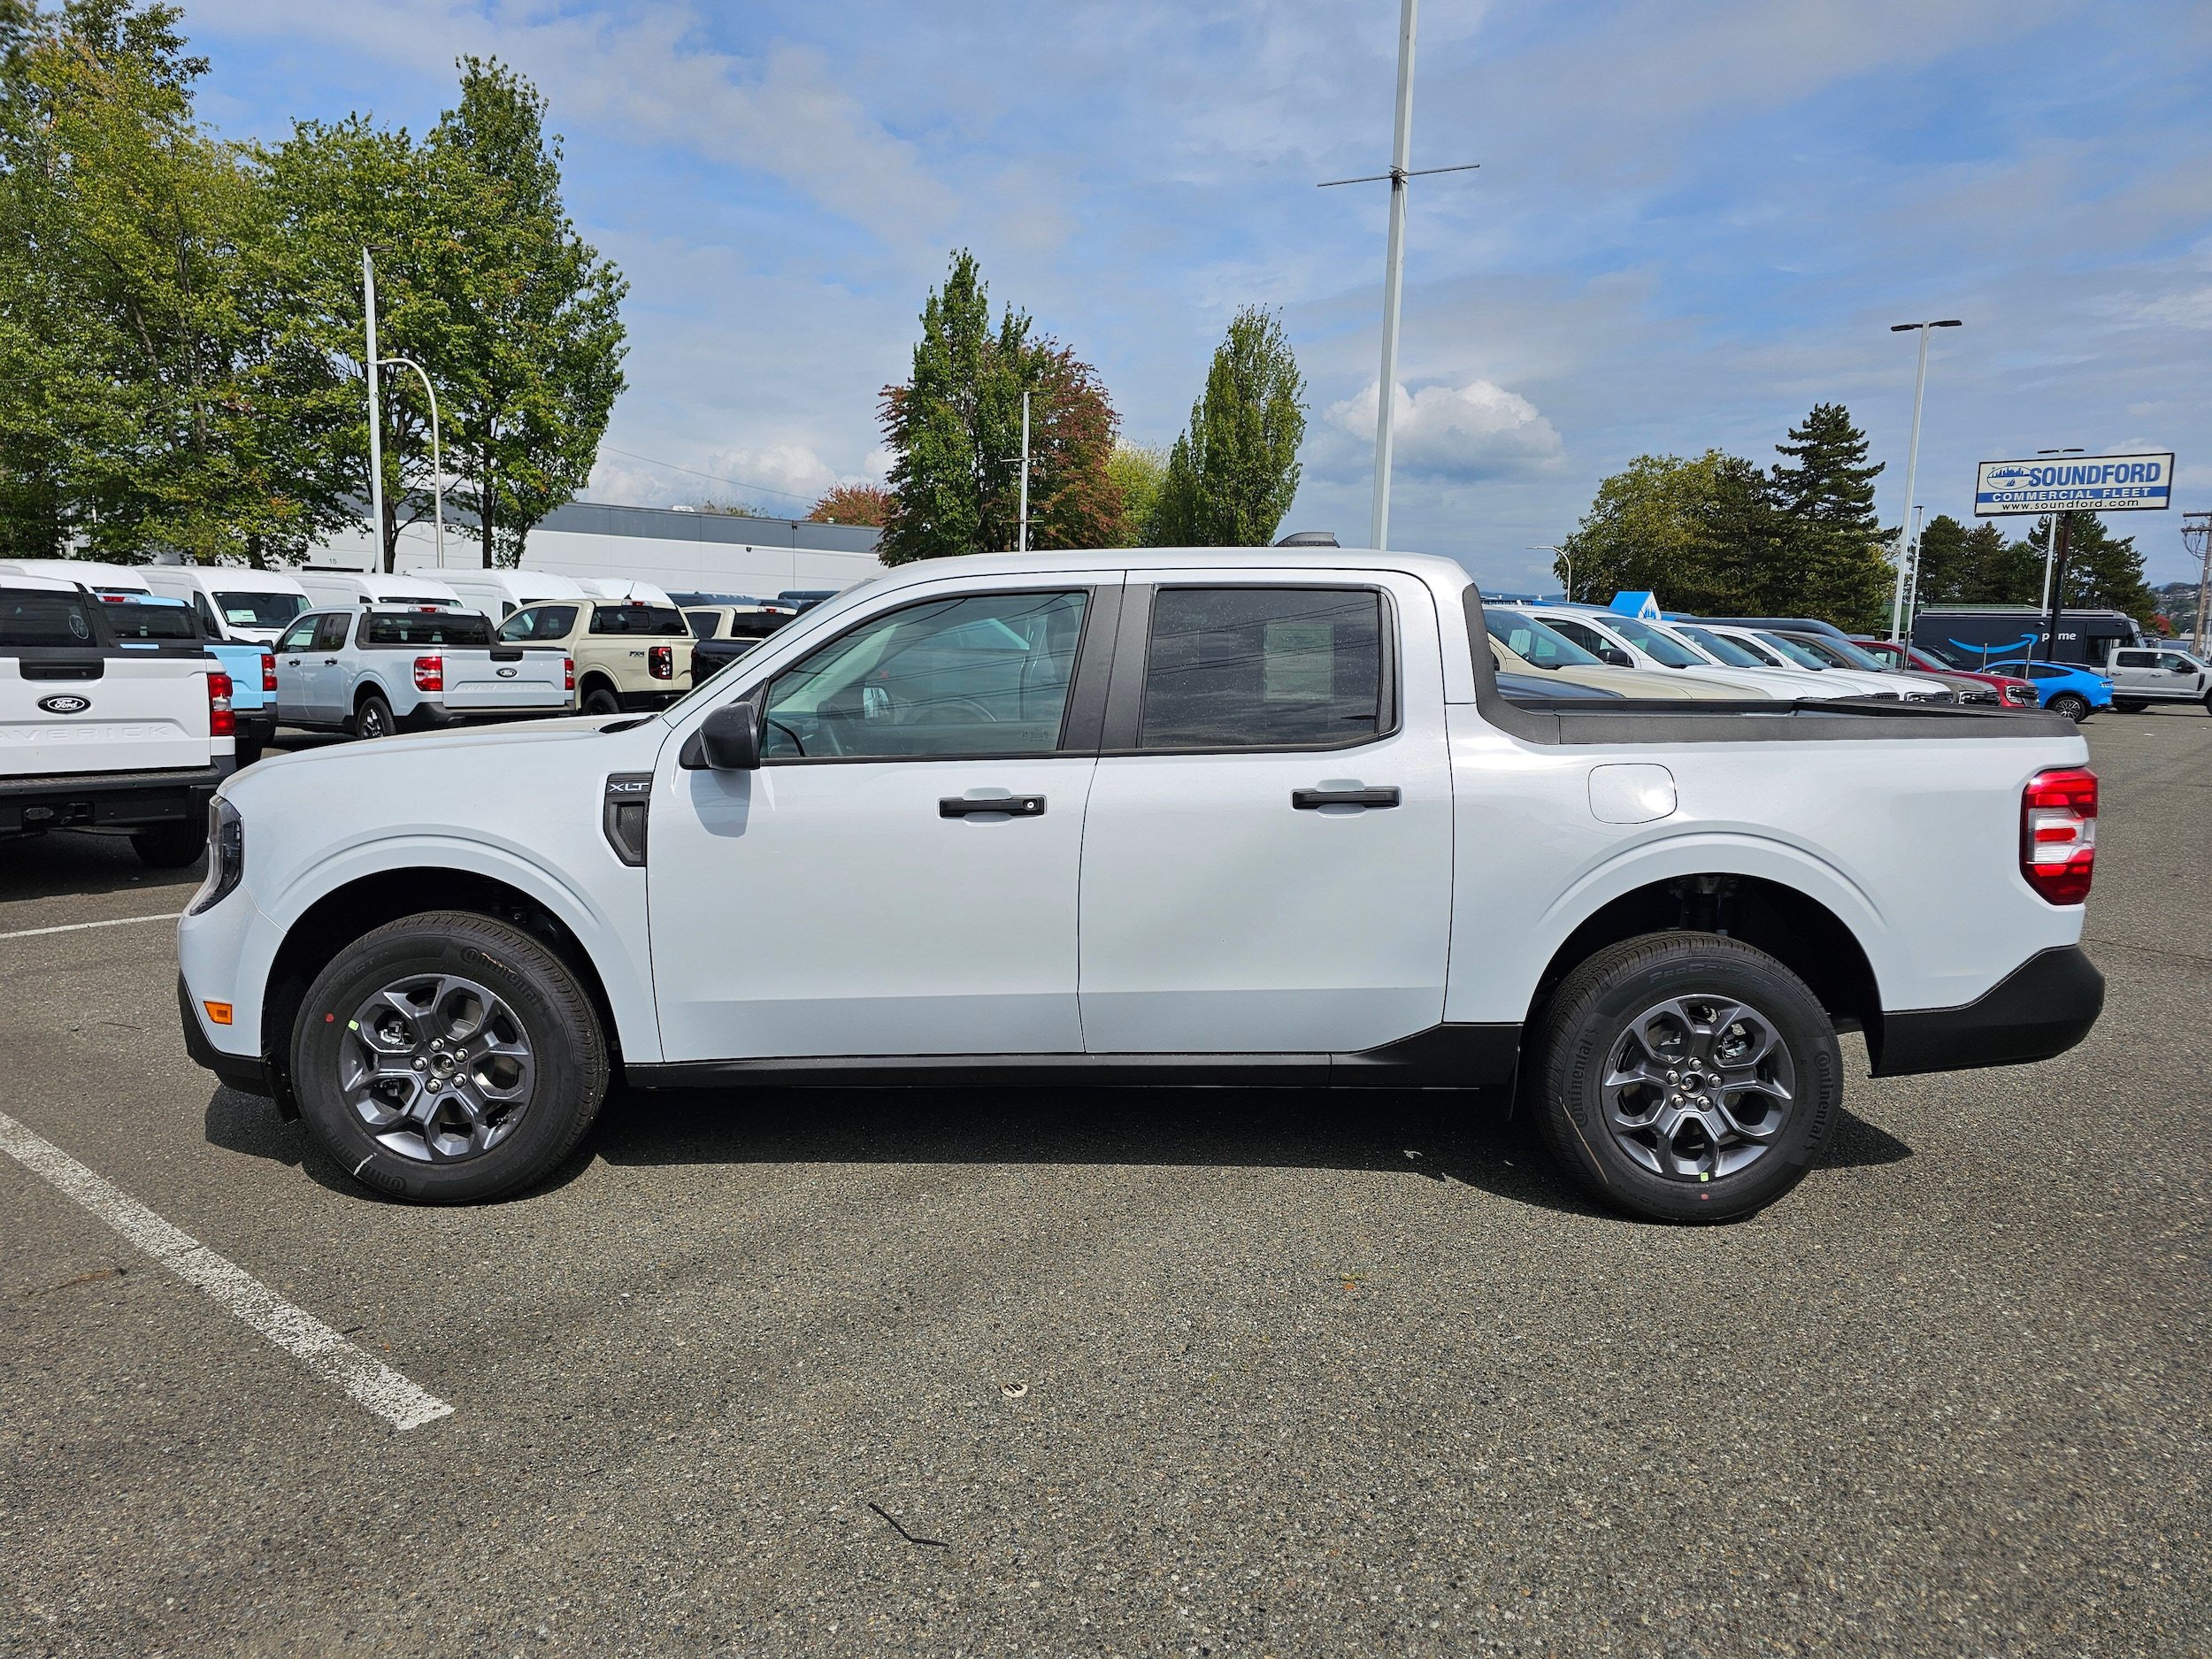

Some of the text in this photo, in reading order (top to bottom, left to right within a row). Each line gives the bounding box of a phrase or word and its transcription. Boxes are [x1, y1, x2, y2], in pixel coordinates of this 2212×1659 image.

[2029, 463, 2161, 487] SOUNDFORD
[1992, 488, 2151, 502] COMMERCIAL FLEET
[2002, 499, 2139, 511] www.soundford.com
[2041, 633, 2077, 642] pme
[54, 699, 78, 709] Ford
[609, 782, 649, 792] XLT
